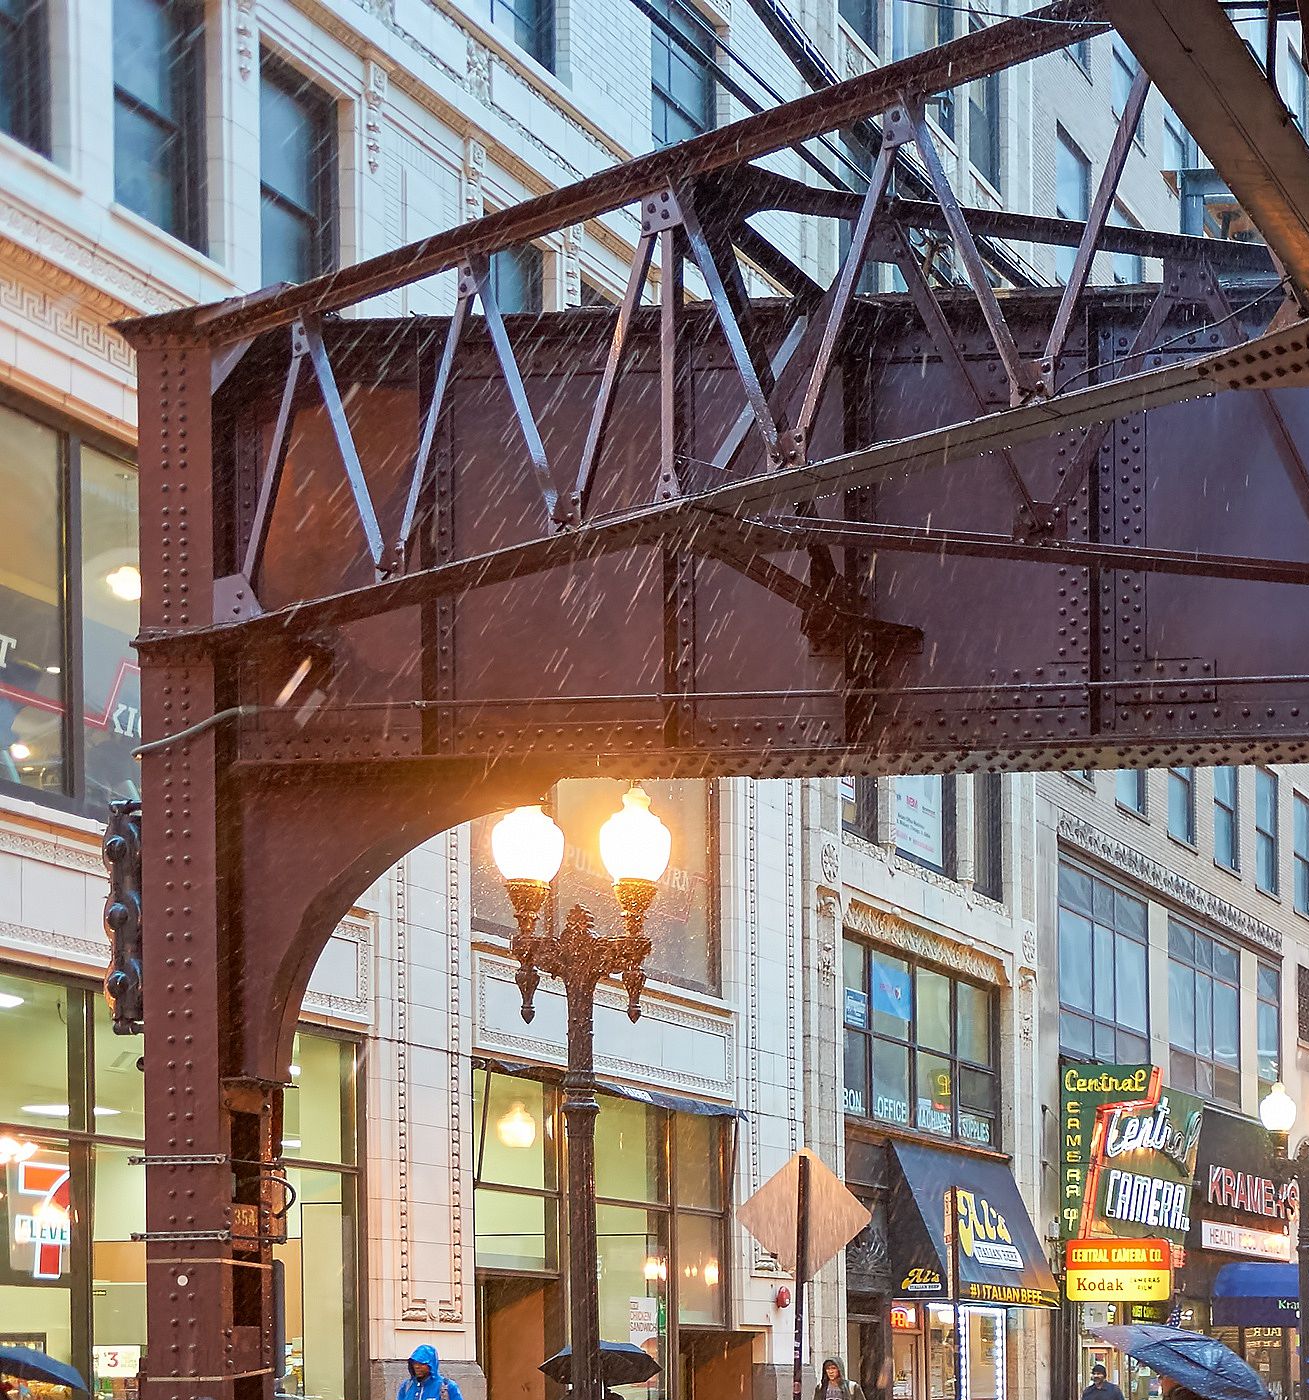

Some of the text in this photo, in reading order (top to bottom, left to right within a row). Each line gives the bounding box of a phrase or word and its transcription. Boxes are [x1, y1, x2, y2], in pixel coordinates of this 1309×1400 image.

[1065, 1069, 1148, 1093] Central
[877, 1096, 907, 1123] OFFICE
[961, 1119, 990, 1144] SUPPLIES
[1106, 1097, 1202, 1163] Central
[1106, 1169, 1186, 1231] CAMERA
[16, 1216, 70, 1242] ELEVE
[1072, 1248, 1109, 1263] CENTRAL
[1112, 1248, 1147, 1263] CAMERA
[902, 1268, 940, 1290] Al's
[1077, 1277, 1124, 1291] Kodak
[982, 1284, 1020, 1303] ITALIAN
[1020, 1289, 1043, 1304] BEEF
[630, 1322, 658, 1333] SANDWICH
